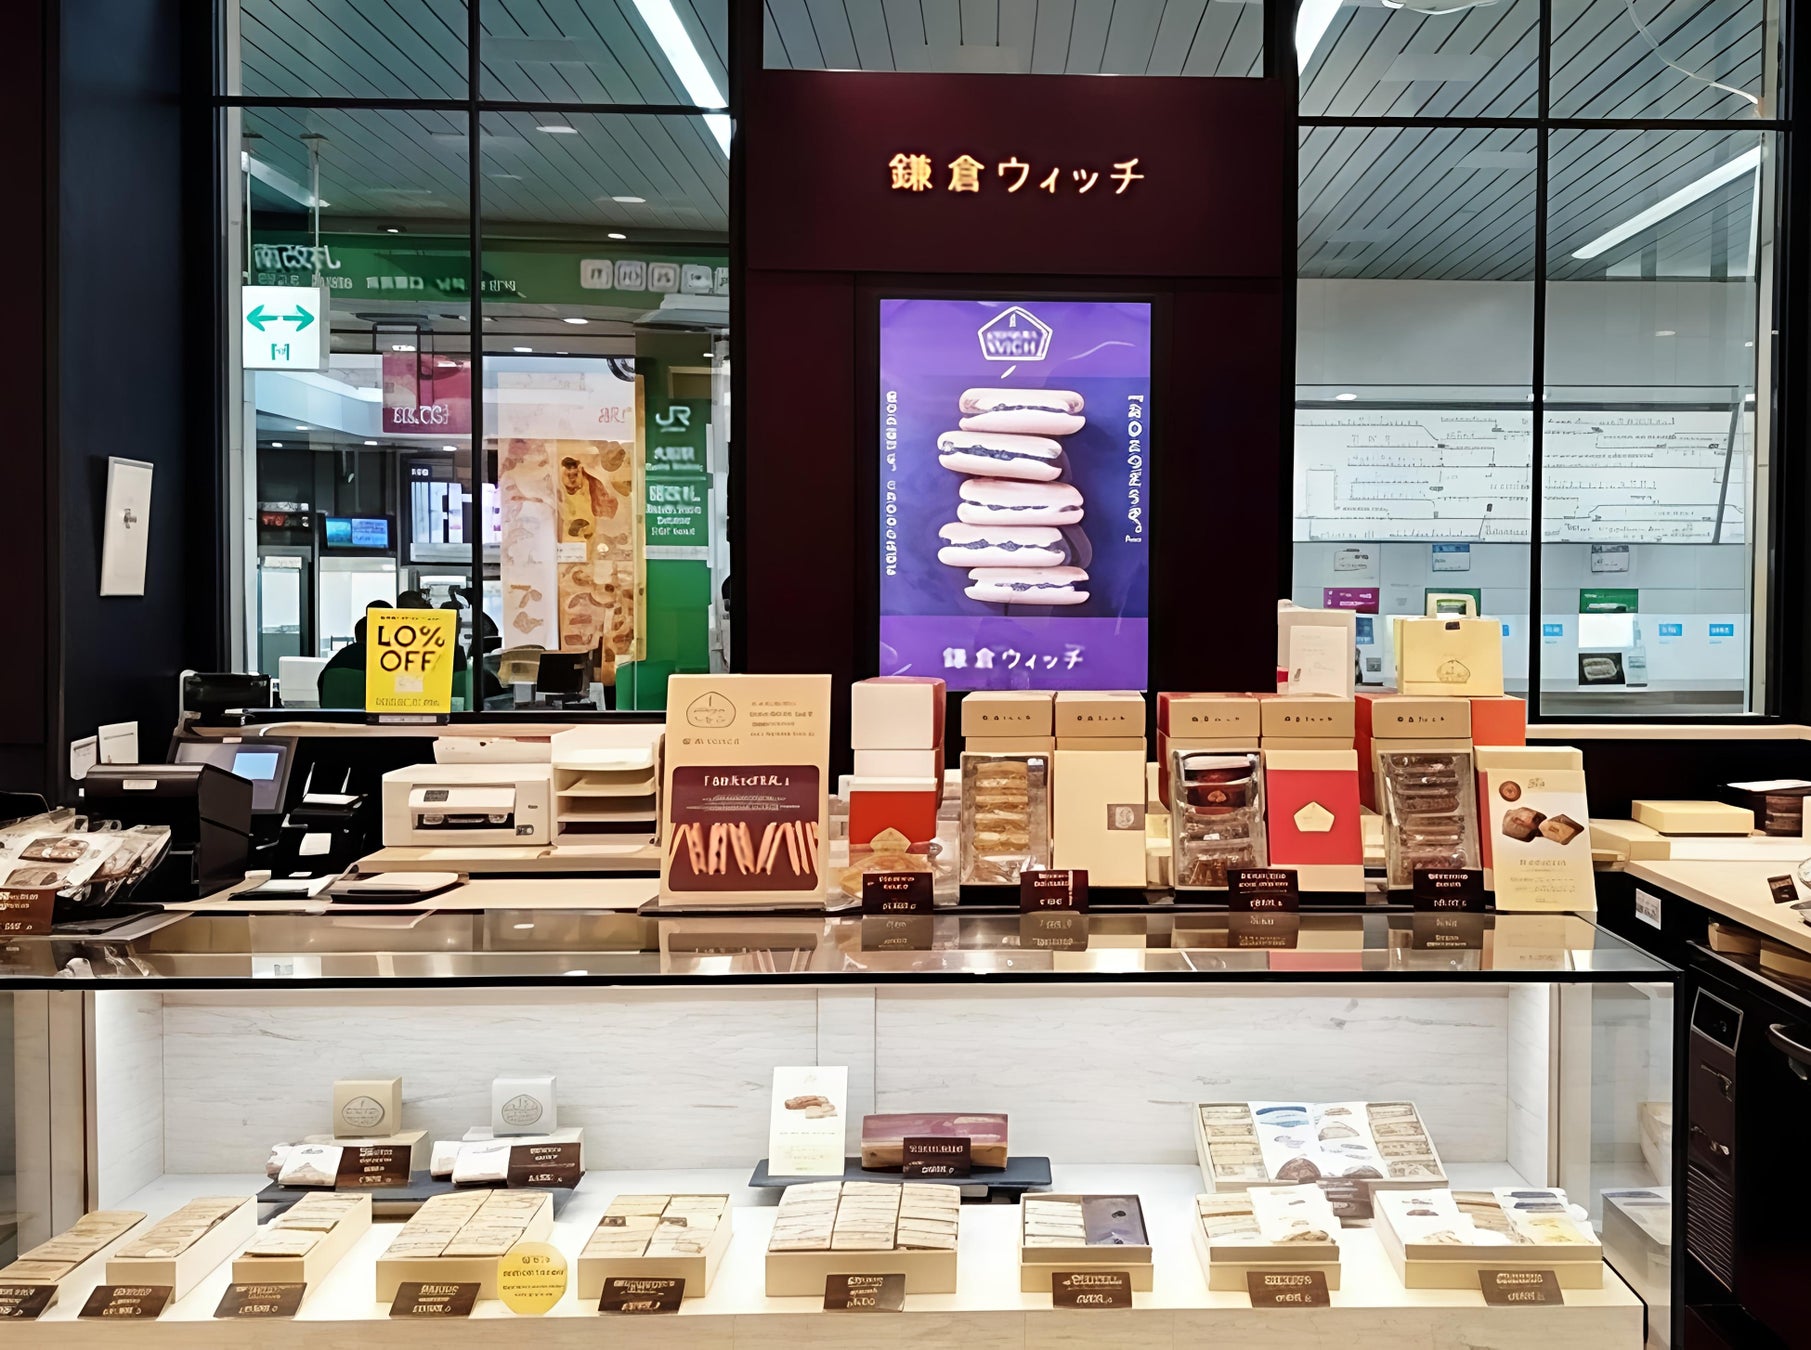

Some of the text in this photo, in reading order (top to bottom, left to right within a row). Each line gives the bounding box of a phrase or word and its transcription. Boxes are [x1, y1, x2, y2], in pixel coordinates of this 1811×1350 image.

[888, 152, 1145, 195] 鎌倉ウィッチ
[655, 405, 692, 427] JR
[380, 649, 436, 673] OFF
